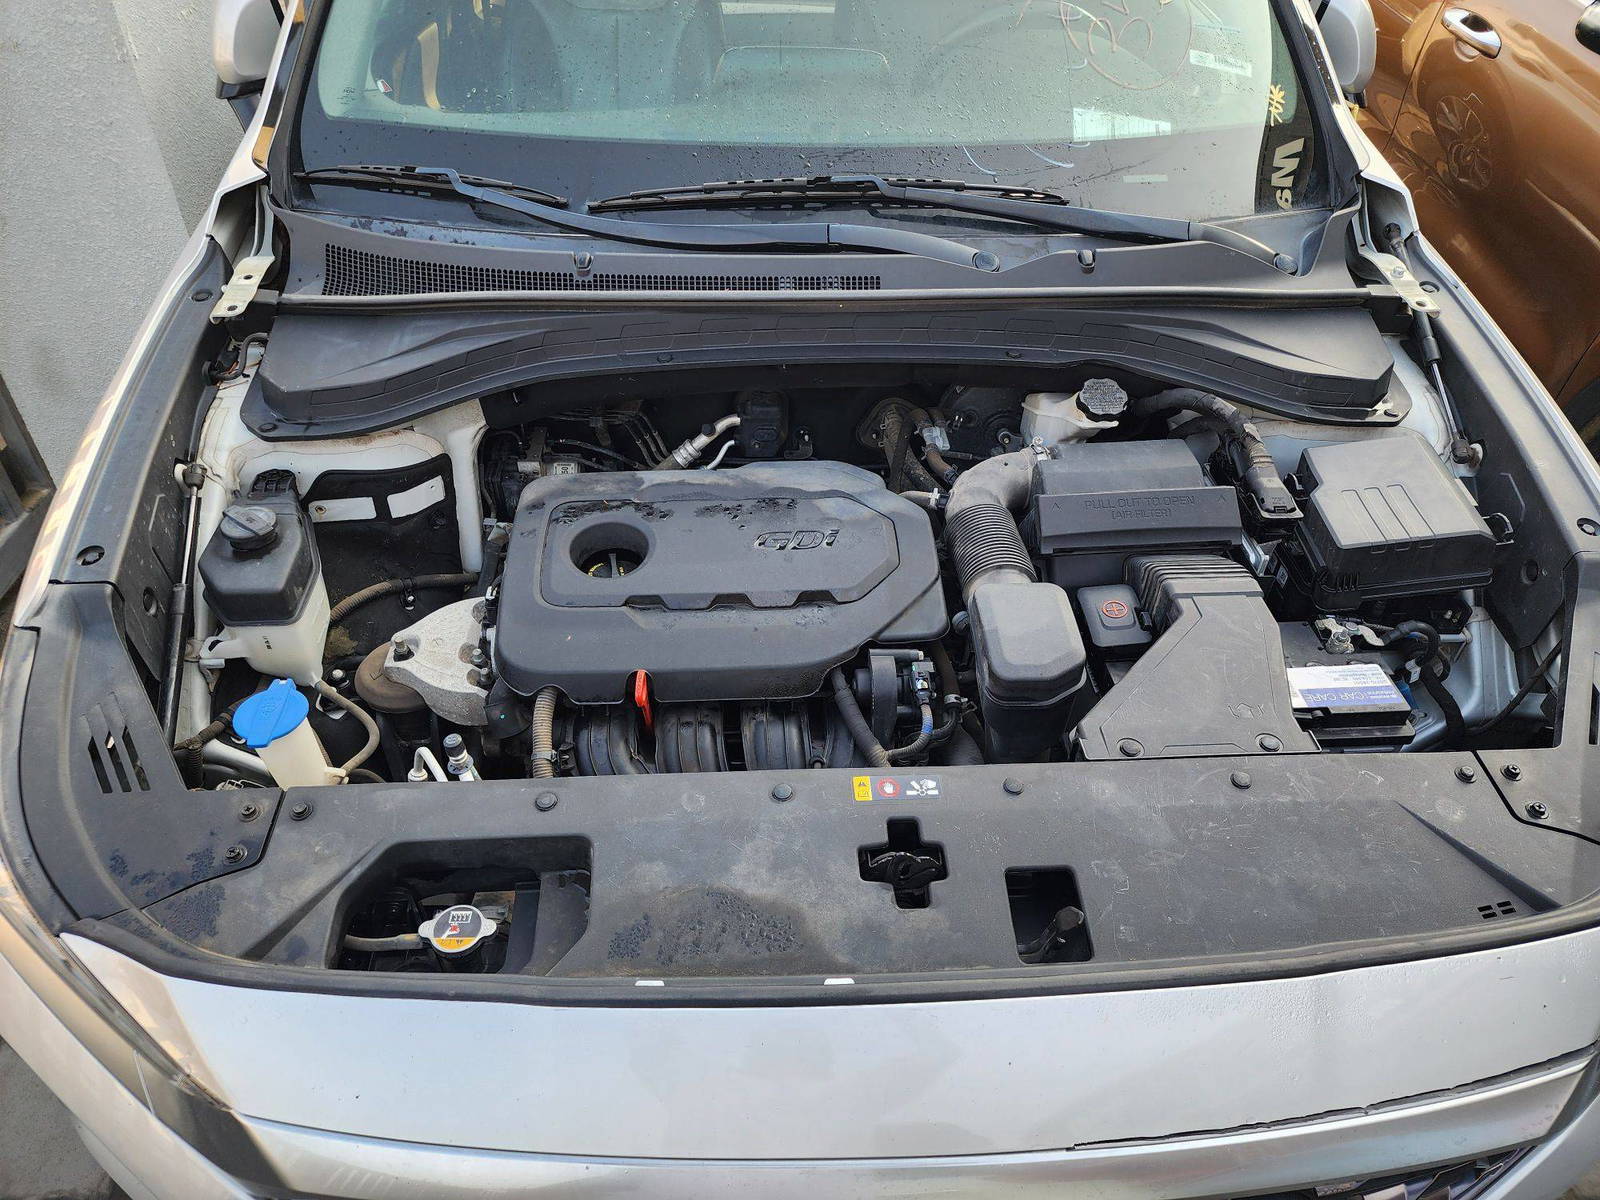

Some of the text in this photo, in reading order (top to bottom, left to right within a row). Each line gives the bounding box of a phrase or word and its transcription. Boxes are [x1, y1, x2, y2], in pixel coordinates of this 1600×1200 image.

[1084, 495, 1195, 510] PULL OUT TO OPEN
[1340, 691, 1365, 700] CAR
